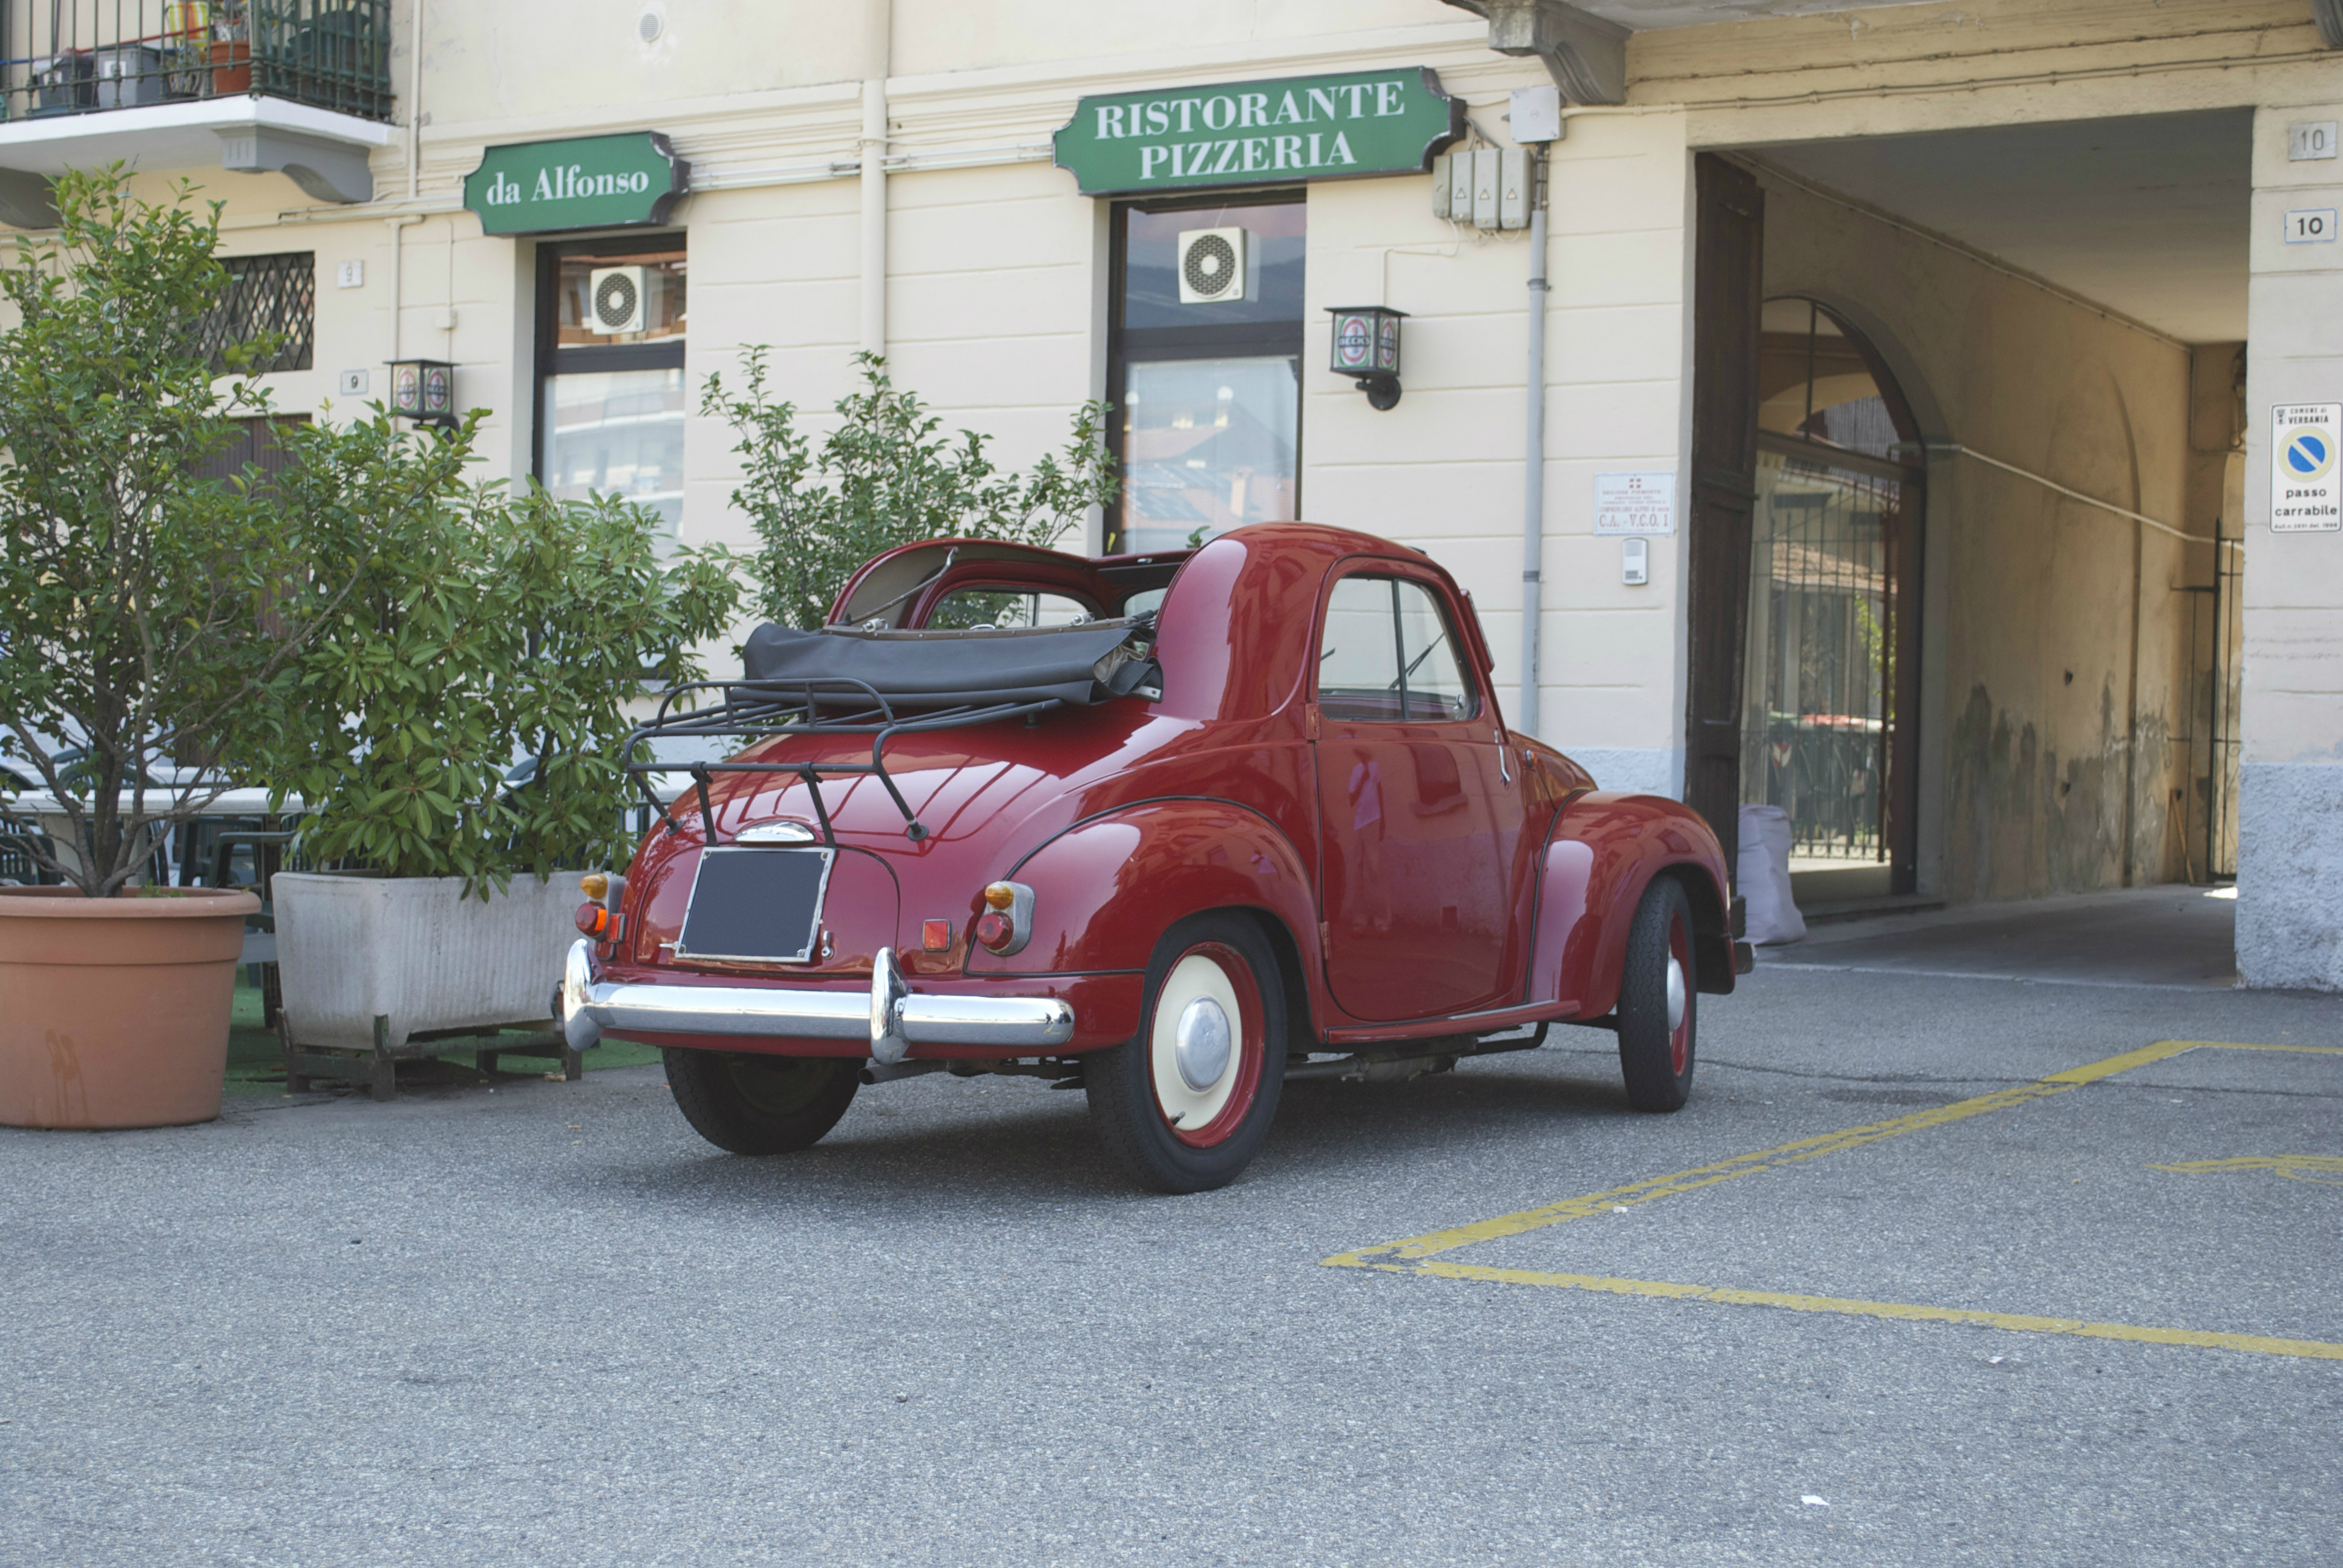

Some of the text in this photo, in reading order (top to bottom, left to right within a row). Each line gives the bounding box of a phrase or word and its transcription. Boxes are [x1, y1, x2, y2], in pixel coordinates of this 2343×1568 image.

[1094, 80, 1405, 140] RISTORANTE
[2301, 129, 2324, 151] 10
[1138, 131, 1357, 180] PIZZERIA
[486, 164, 649, 206] da Alfonso
[2297, 217, 2324, 236] 10
[350, 374, 359, 389] 9
[2288, 416, 2329, 425] VERBANIA
[2286, 488, 2327, 500] passo
[2275, 505, 2338, 517] carrabile
[1599, 514, 1620, 528] C.A.
[1629, 513, 1659, 527] V.C.O.
[1663, 514, 1668, 528] 1
